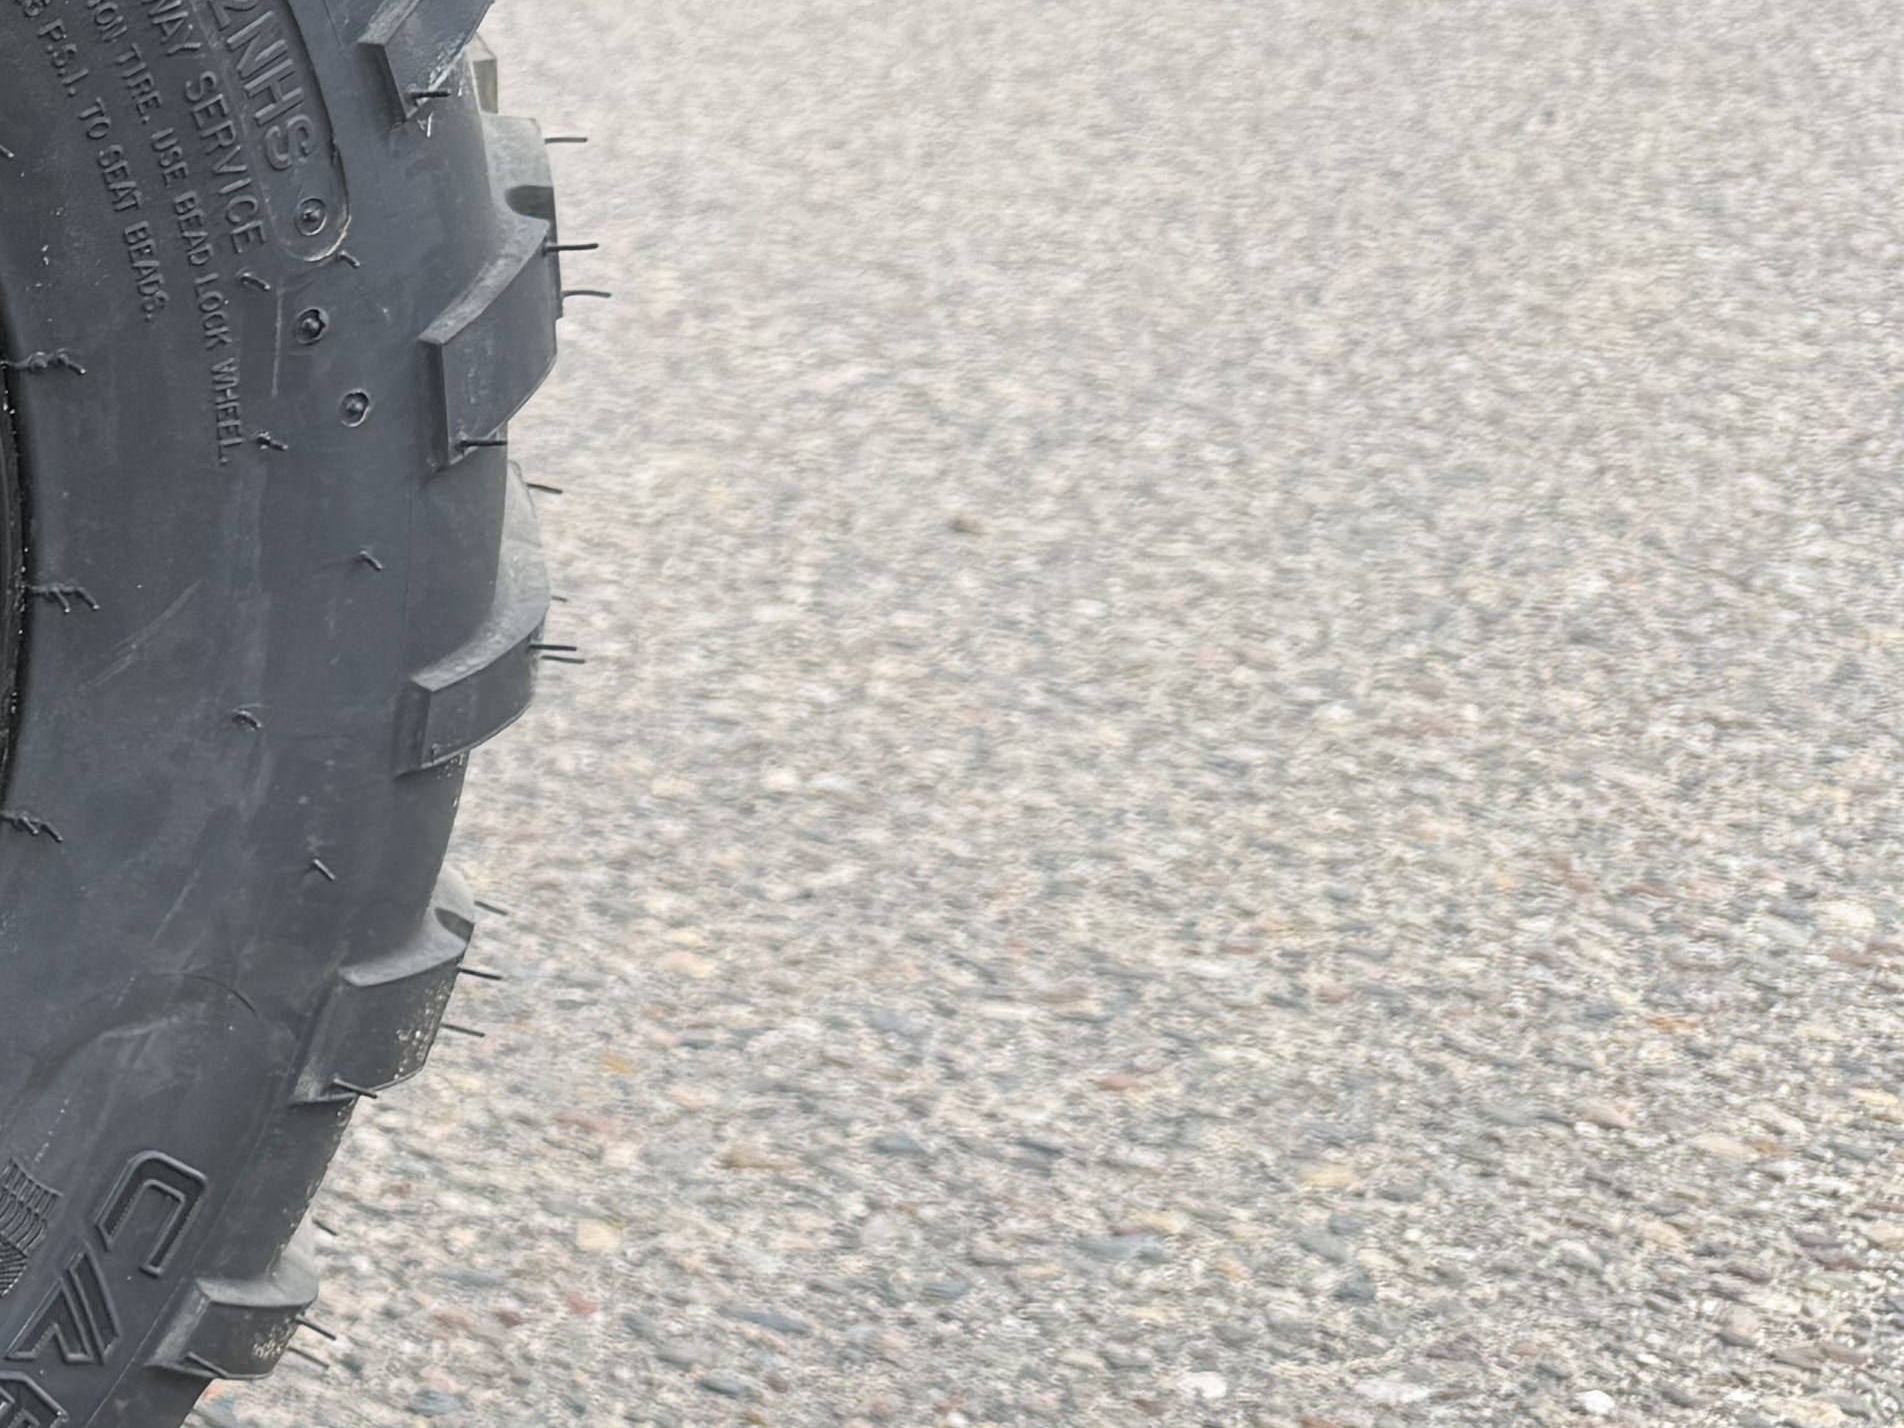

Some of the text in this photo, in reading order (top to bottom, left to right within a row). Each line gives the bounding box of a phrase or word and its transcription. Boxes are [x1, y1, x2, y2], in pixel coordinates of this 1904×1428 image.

[77, 95, 111, 141] TO
[97, 143, 142, 213] SEAT
[151, 127, 189, 189] USE
[172, 189, 213, 267] BEAD
[193, 272, 234, 353] LOCK
[184, 69, 268, 255] SERVICE
